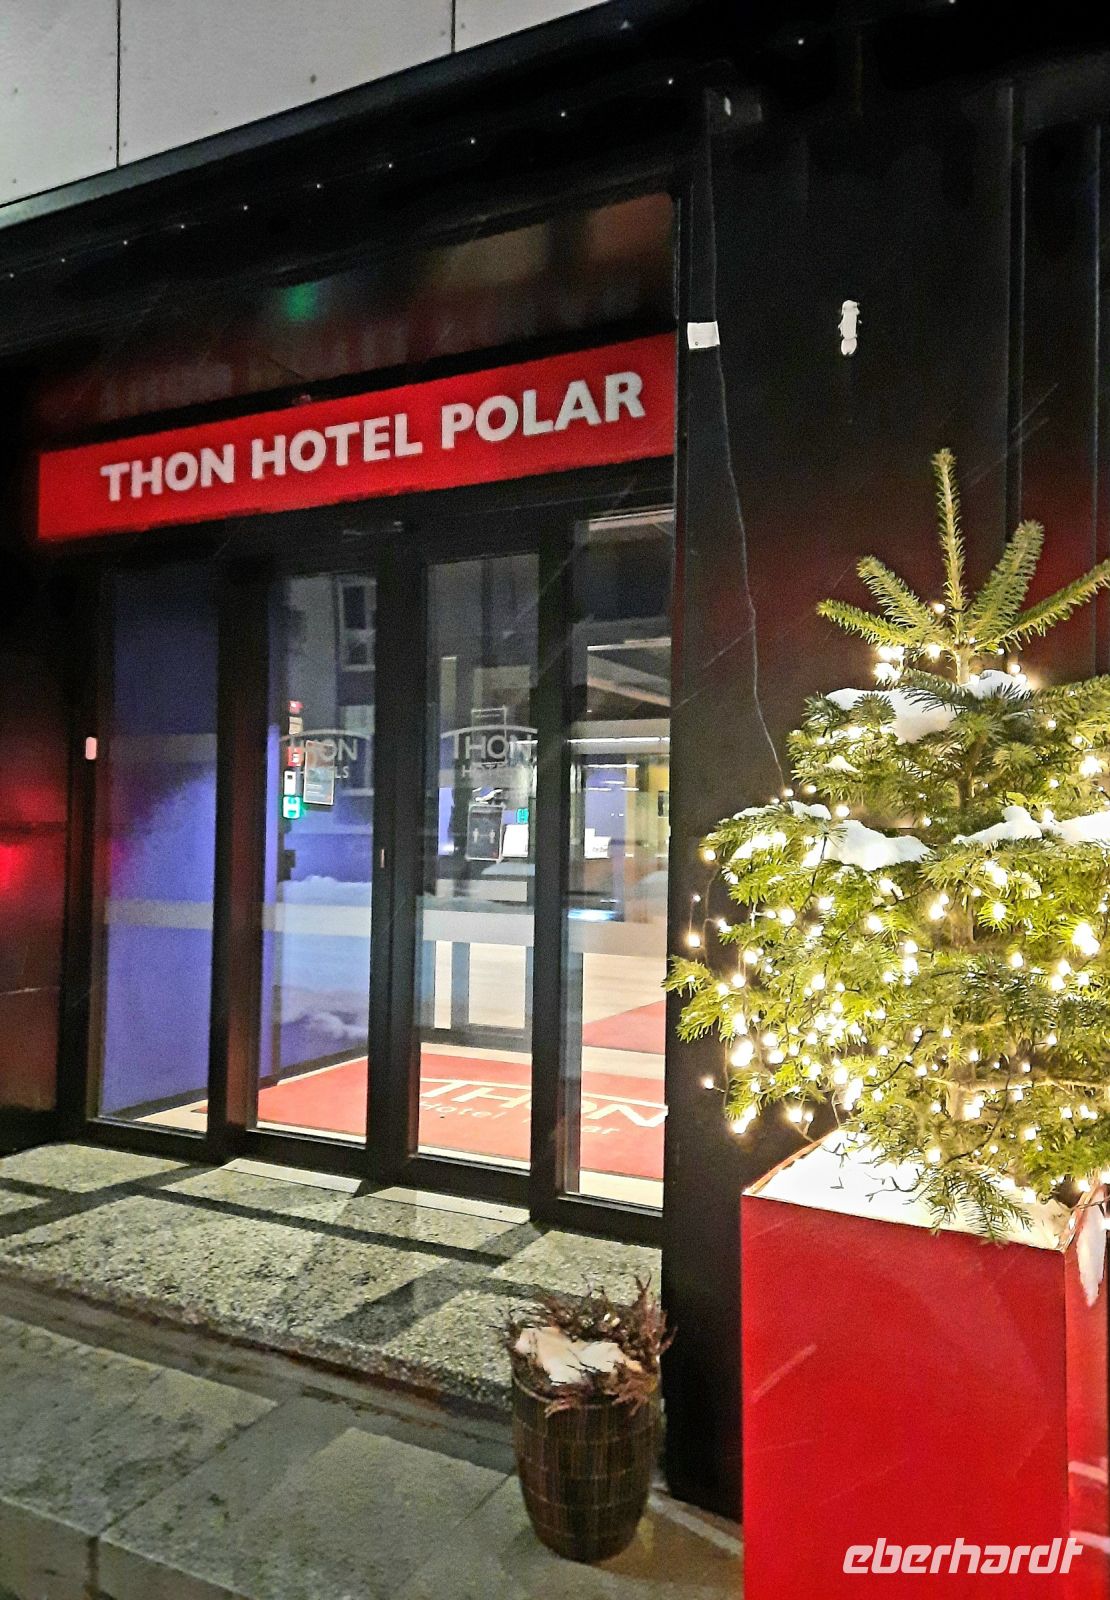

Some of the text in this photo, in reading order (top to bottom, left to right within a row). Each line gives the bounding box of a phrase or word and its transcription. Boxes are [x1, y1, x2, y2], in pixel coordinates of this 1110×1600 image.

[101, 371, 646, 503] THON HOTEL POLAR
